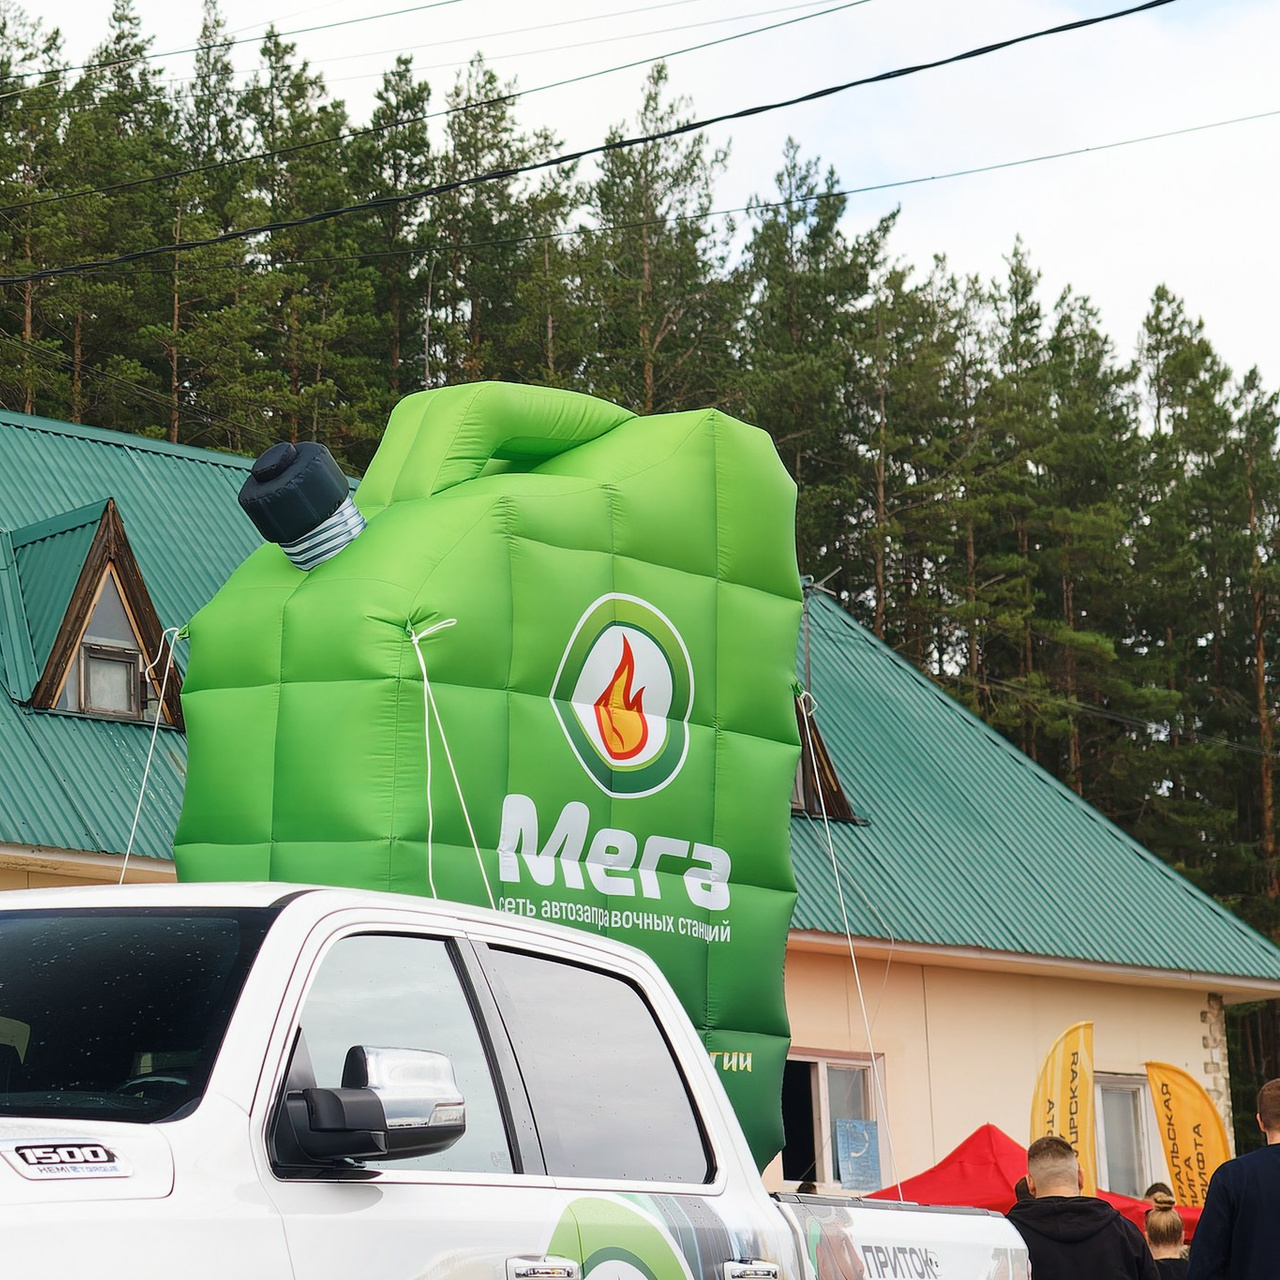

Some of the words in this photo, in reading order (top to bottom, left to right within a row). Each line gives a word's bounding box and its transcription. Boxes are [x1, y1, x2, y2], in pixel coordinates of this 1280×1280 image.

[497, 793, 731, 910] Мега
[498, 896, 536, 916] сеть
[541, 898, 675, 932] автозаправочных
[678, 917, 731, 944] станций
[19, 1145, 109, 1164] 1500
[1193, 1123, 1208, 1203] РИФТА
[861, 1245, 938, 1279] ПРИТОК
